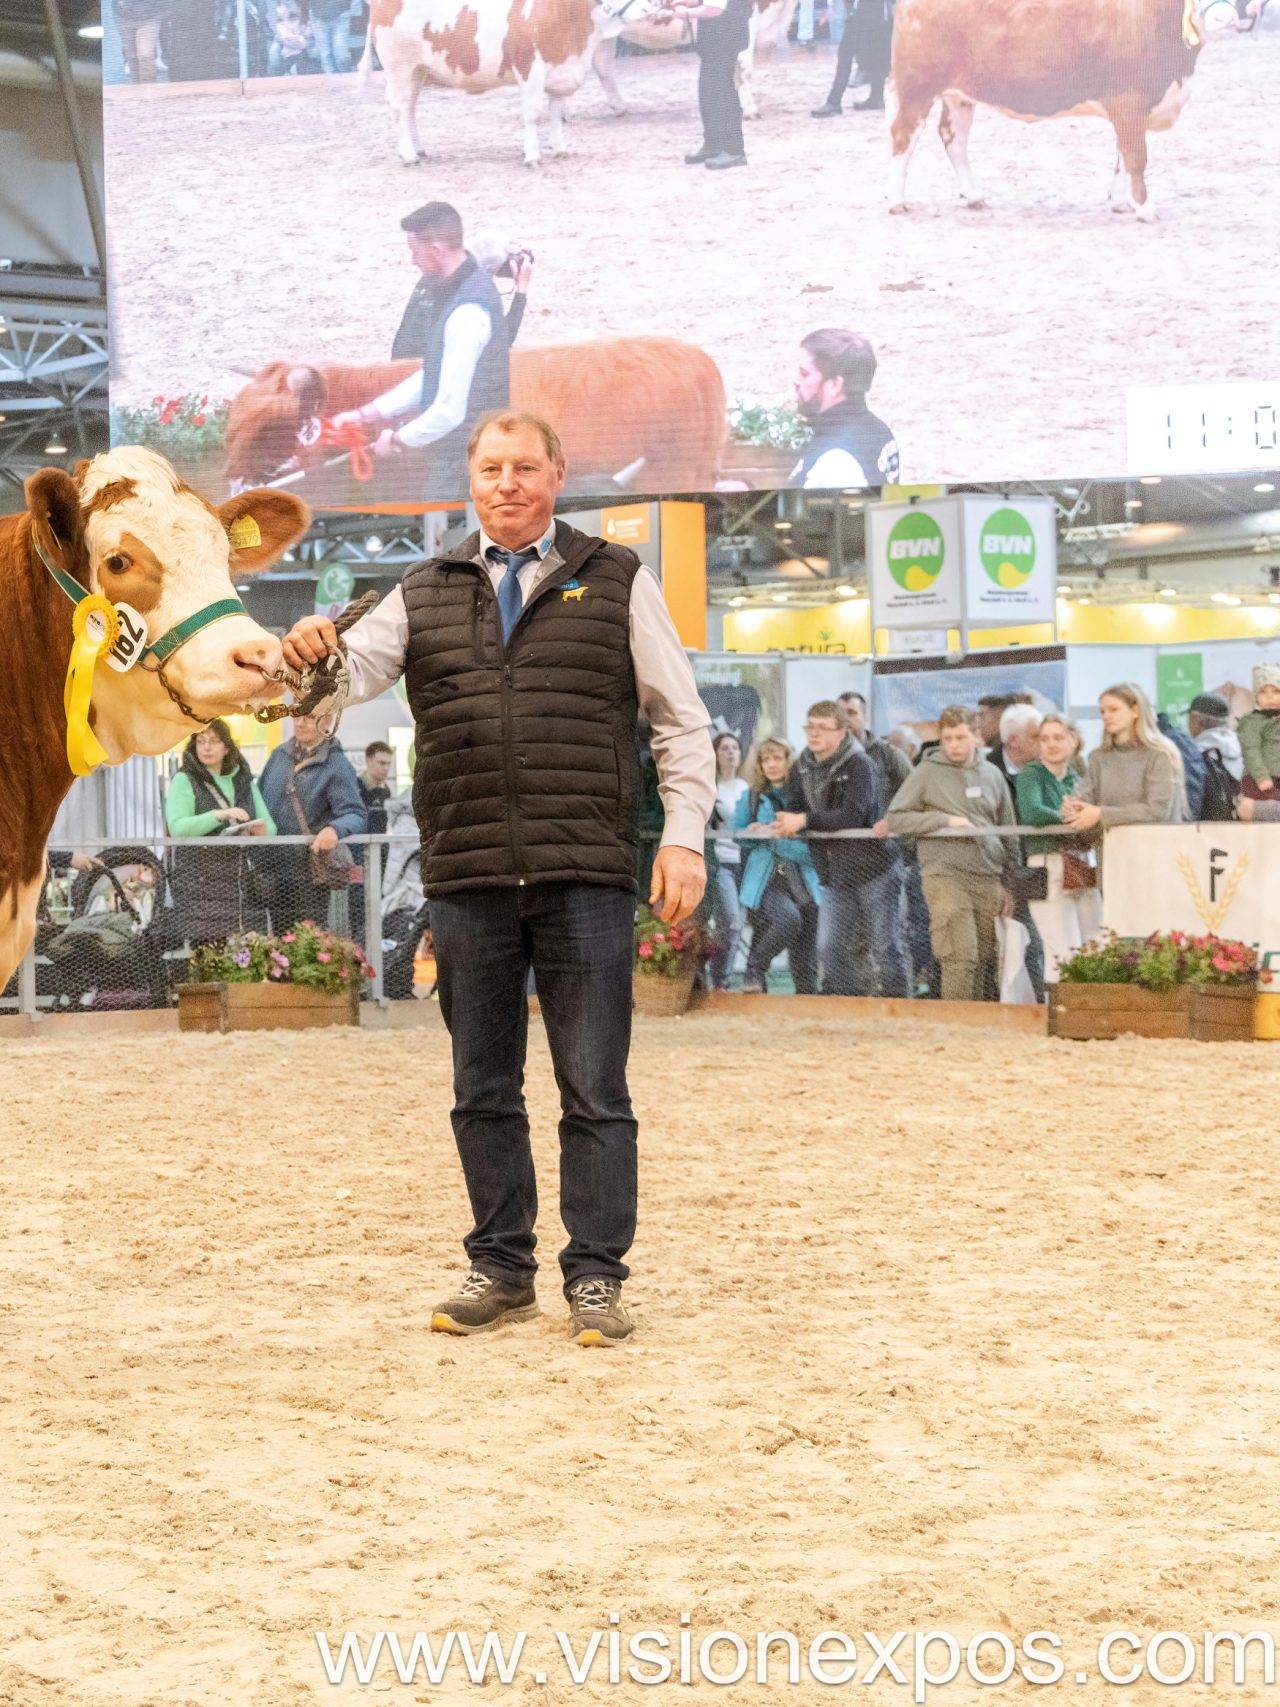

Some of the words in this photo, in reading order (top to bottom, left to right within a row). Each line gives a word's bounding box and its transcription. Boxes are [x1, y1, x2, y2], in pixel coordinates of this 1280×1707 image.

[890, 537, 941, 559] BVN
[983, 534, 1033, 554] BVN
[109, 609, 145, 666] 162
